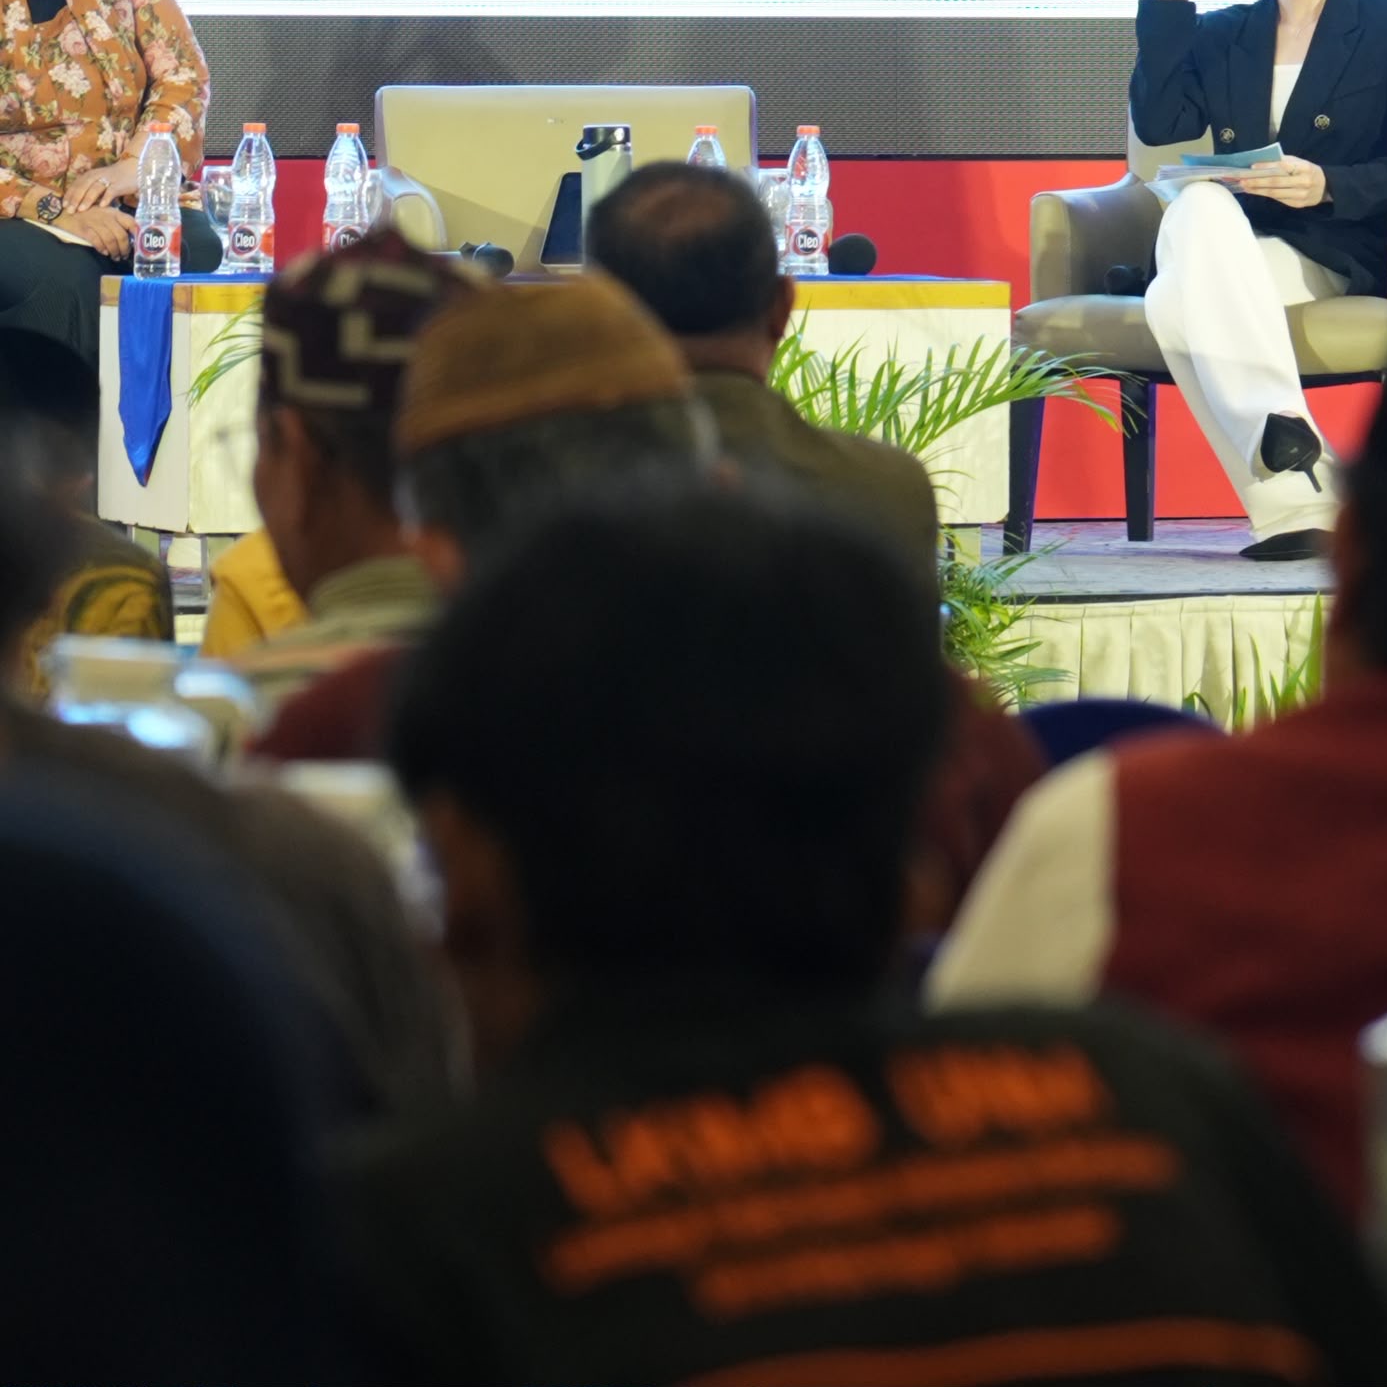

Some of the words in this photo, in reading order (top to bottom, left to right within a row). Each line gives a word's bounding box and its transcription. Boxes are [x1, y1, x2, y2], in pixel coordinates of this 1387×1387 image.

[143, 232, 166, 249] Cleo
[235, 232, 256, 249] Cleo
[797, 233, 818, 249] Cleo
